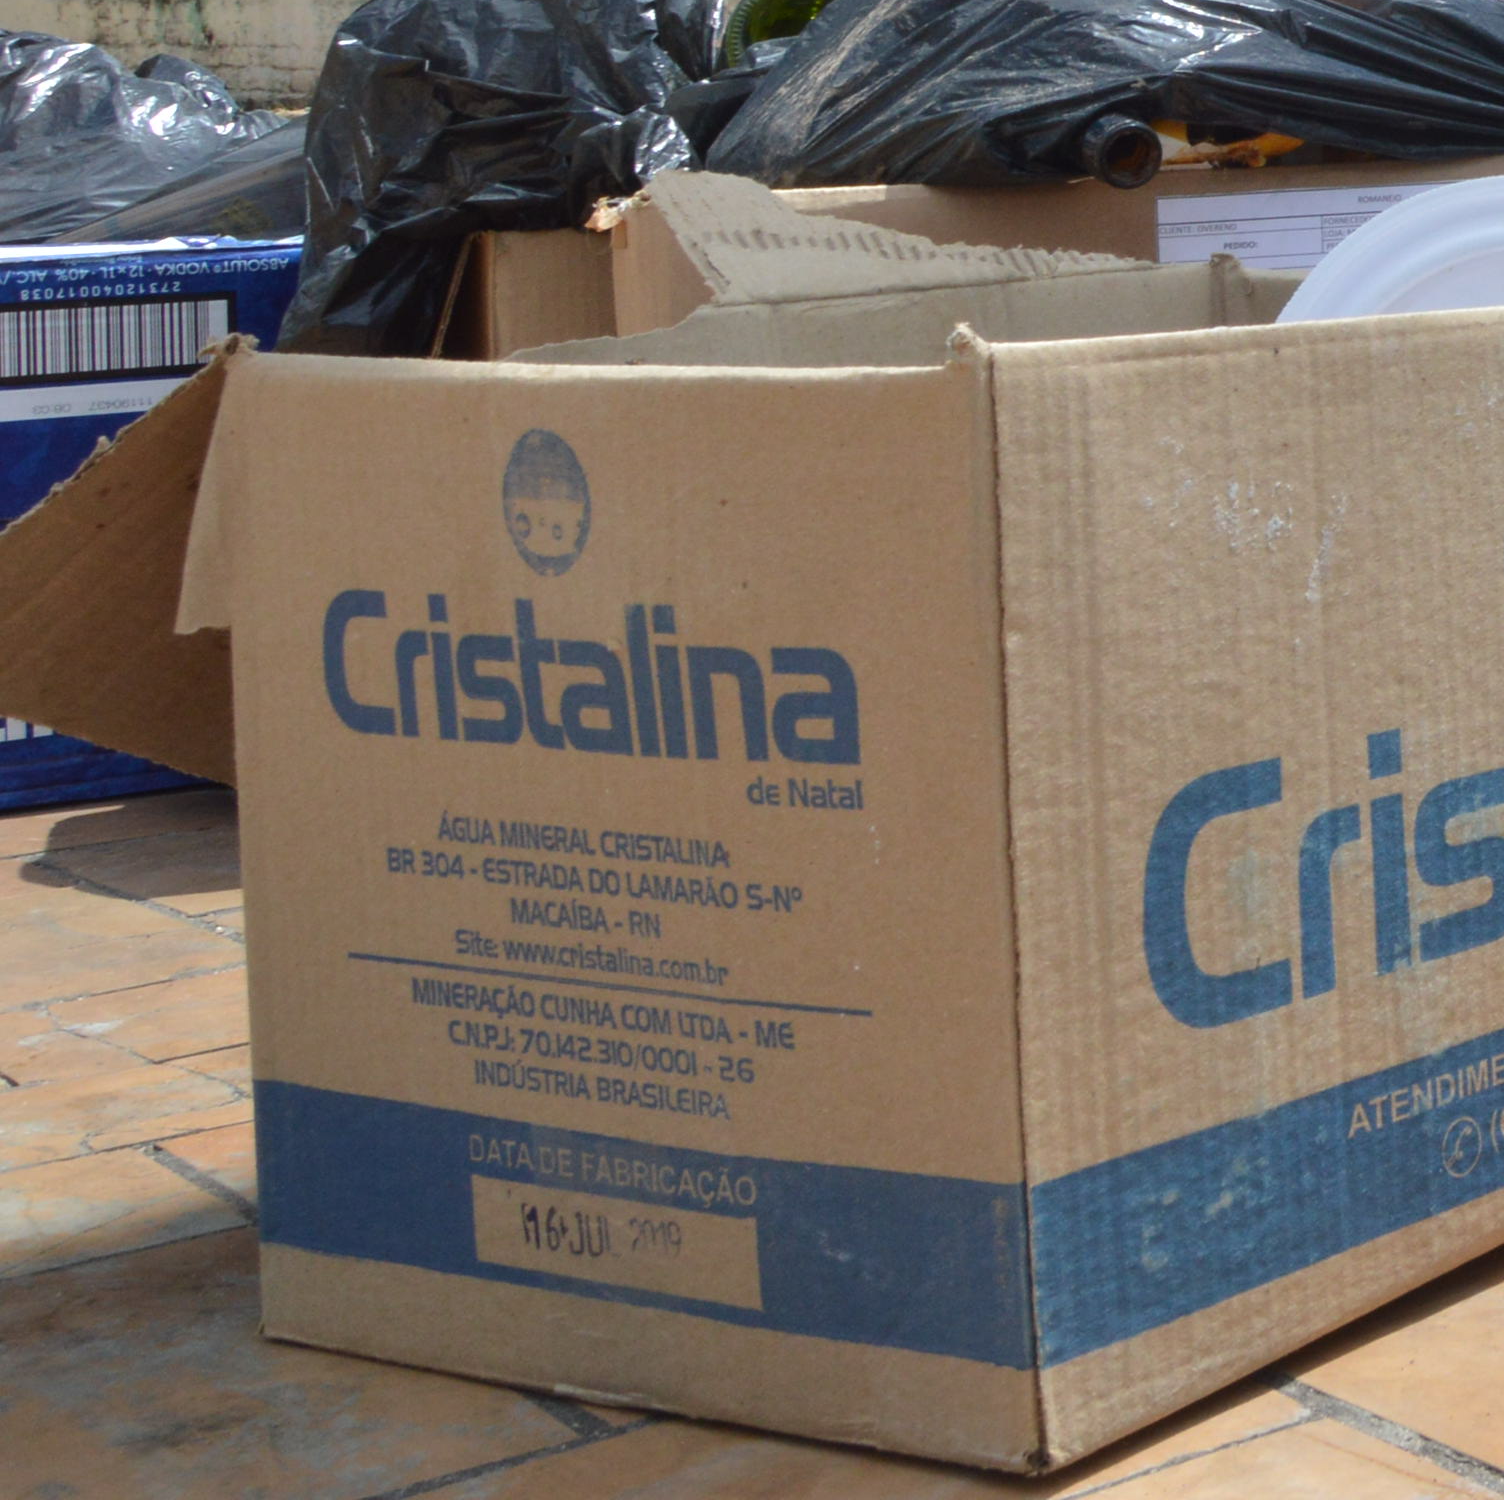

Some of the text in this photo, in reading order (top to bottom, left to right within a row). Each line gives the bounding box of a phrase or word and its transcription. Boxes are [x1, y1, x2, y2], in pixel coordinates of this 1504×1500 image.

[54, 266, 87, 282] 40%
[154, 260, 209, 276] VODKA
[322, 589, 862, 767] Cristalina
[746, 776, 865, 810] de Natal
[438, 810, 730, 868] ÁGUA MINERAL CRISTALINA
[387, 847, 416, 874] BR
[421, 851, 465, 879] 304
[482, 858, 585, 892] ESTRADA
[588, 868, 620, 897] DO
[626, 872, 739, 909] LAMARÃO
[510, 897, 611, 934] MACAÍBA
[628, 911, 662, 939] RN
[502, 940, 729, 987] www.cristalina.com.br
[411, 977, 536, 1019] MINERAÇÃO
[540, 993, 617, 1030] CUNHA
[621, 1004, 673, 1036] COM
[678, 1011, 733, 1044] LTDA
[754, 1020, 796, 1050] ME
[475, 1059, 731, 1121] INDÚSTRIA BRASILEIRA
[718, 1056, 756, 1084] 26
[468, 1134, 758, 1208] DATA DE FABRICAÇÃO
